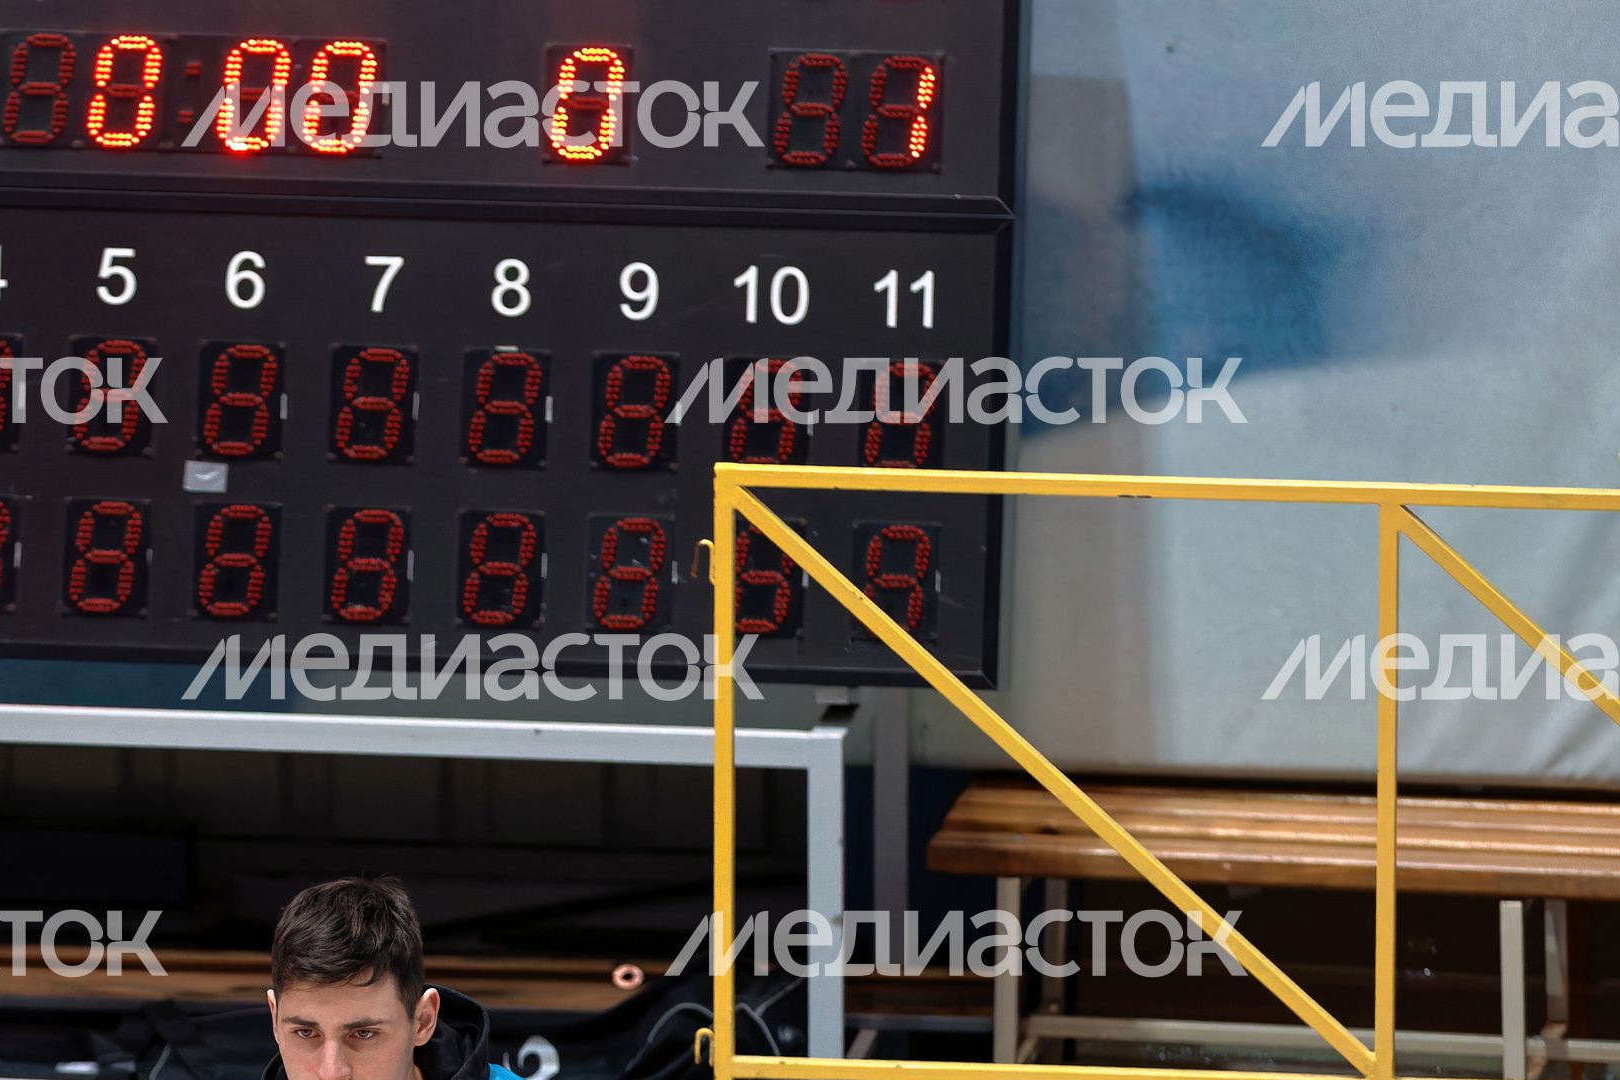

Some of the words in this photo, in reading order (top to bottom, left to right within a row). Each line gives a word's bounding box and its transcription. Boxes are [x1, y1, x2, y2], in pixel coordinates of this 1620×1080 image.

[549, 47, 625, 160] 0
[97, 247, 137, 305] 5
[225, 250, 266, 309] 6
[365, 255, 404, 312] 7
[491, 258, 531, 317] 8
[619, 261, 659, 321] 9
[734, 265, 810, 325] 10
[874, 269, 934, 329] 11
